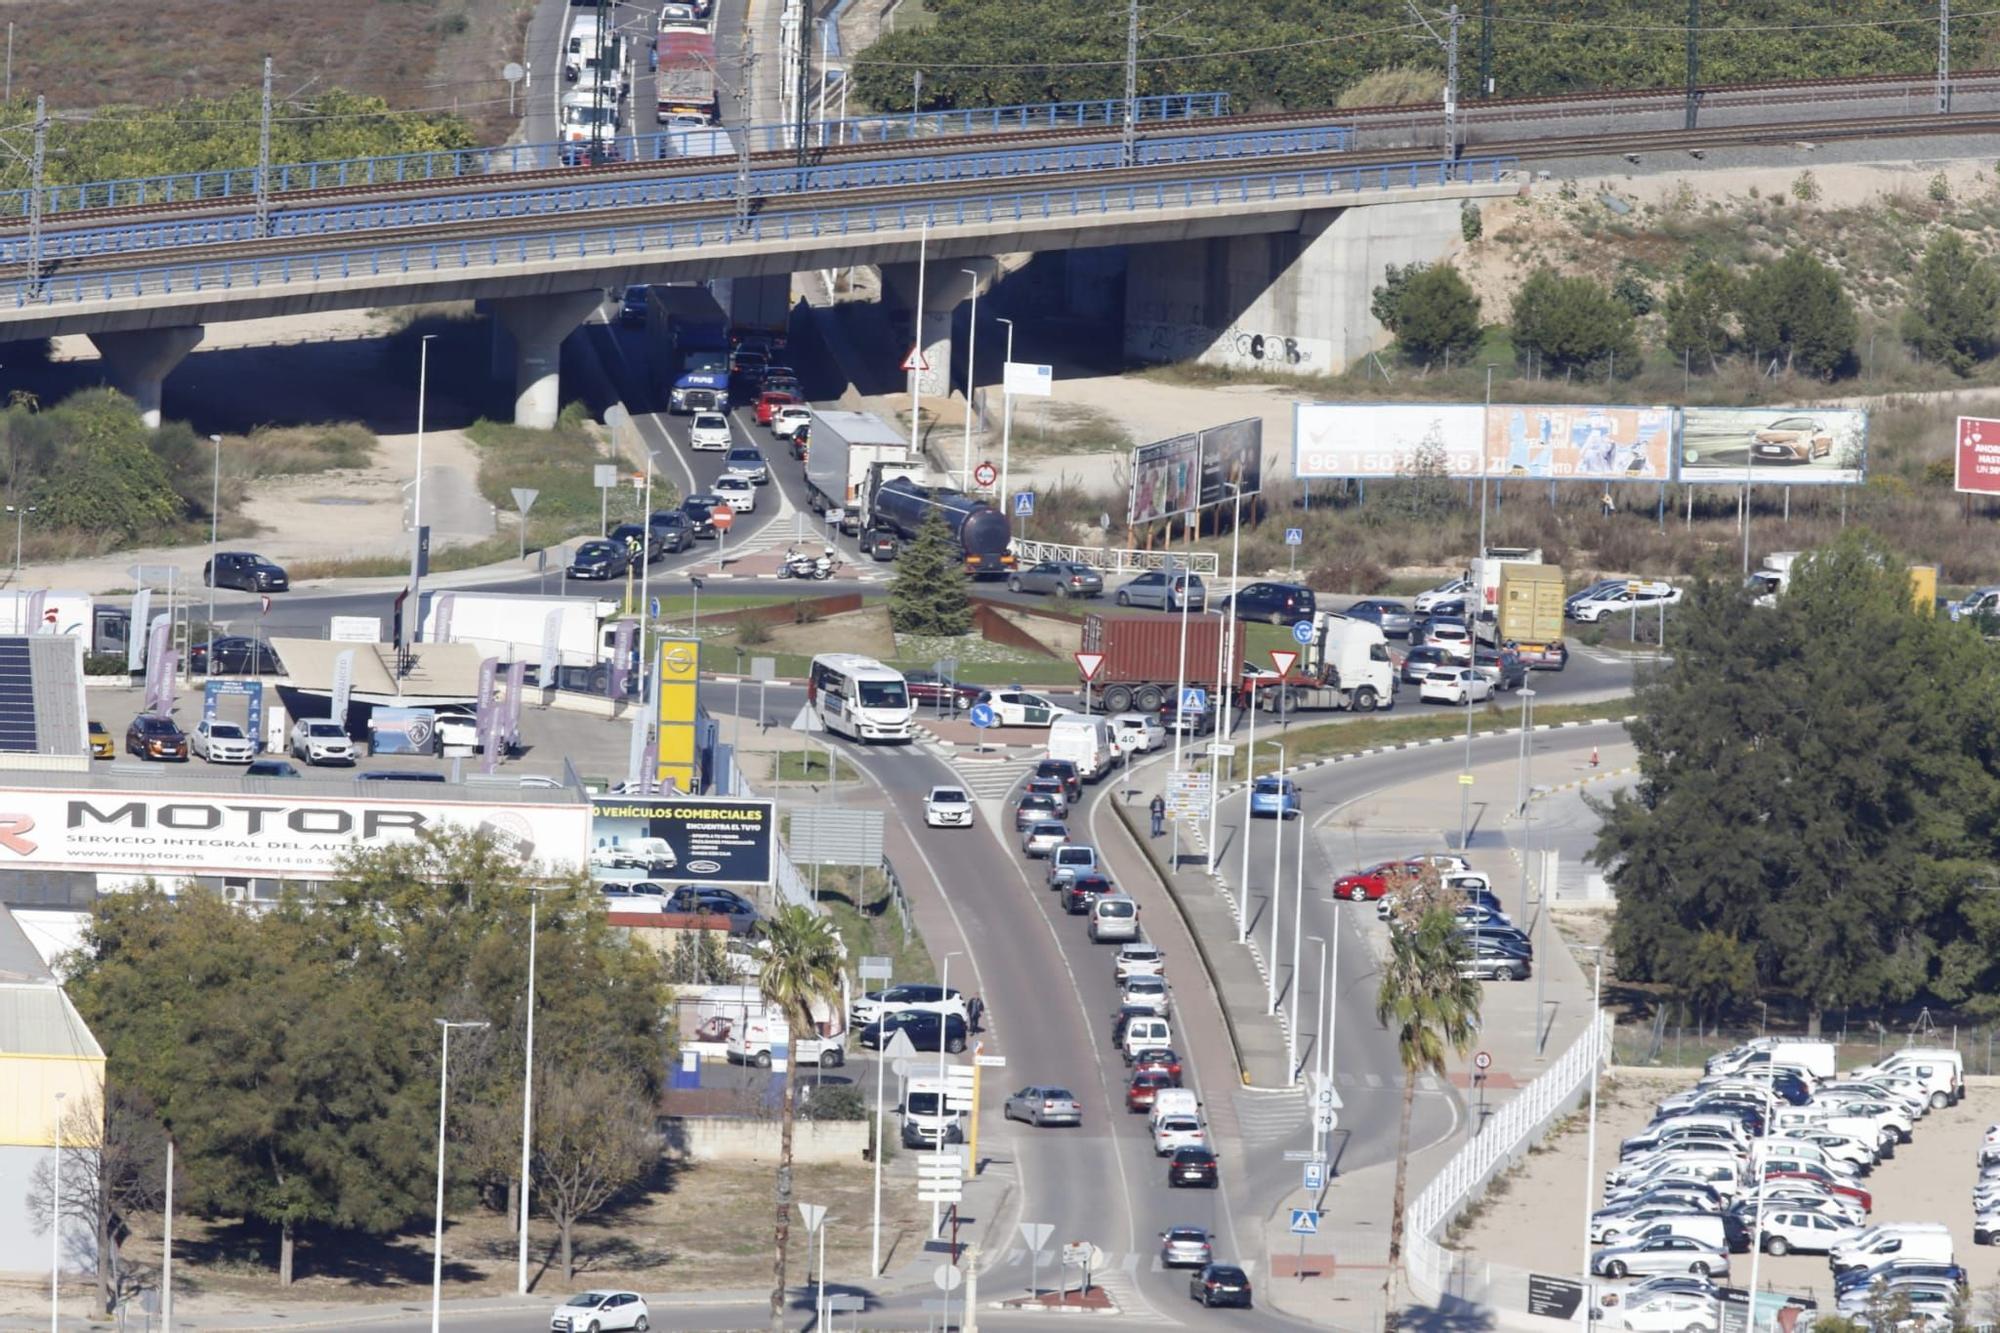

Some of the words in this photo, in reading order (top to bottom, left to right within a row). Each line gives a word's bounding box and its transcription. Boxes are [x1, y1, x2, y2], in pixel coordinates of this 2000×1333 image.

[1309, 454, 1338, 470] 96
[1350, 454, 1394, 471] 150
[1978, 455, 2000, 464] HAST
[1121, 735, 1136, 743] 40
[602, 804, 673, 818] VEHÍCULOS
[674, 807, 763, 821] COMERCIALES
[68, 801, 430, 838] MOTOR
[686, 823, 731, 831] ENCUENTRA
[67, 834, 157, 845] SERVICIO
[164, 838, 259, 849] INTEGRAL
[267, 841, 304, 850] DEL
[310, 843, 384, 852] AUTOM
[67, 850, 205, 861] www.rrmotor.es
[1320, 1116, 1332, 1124] 70
